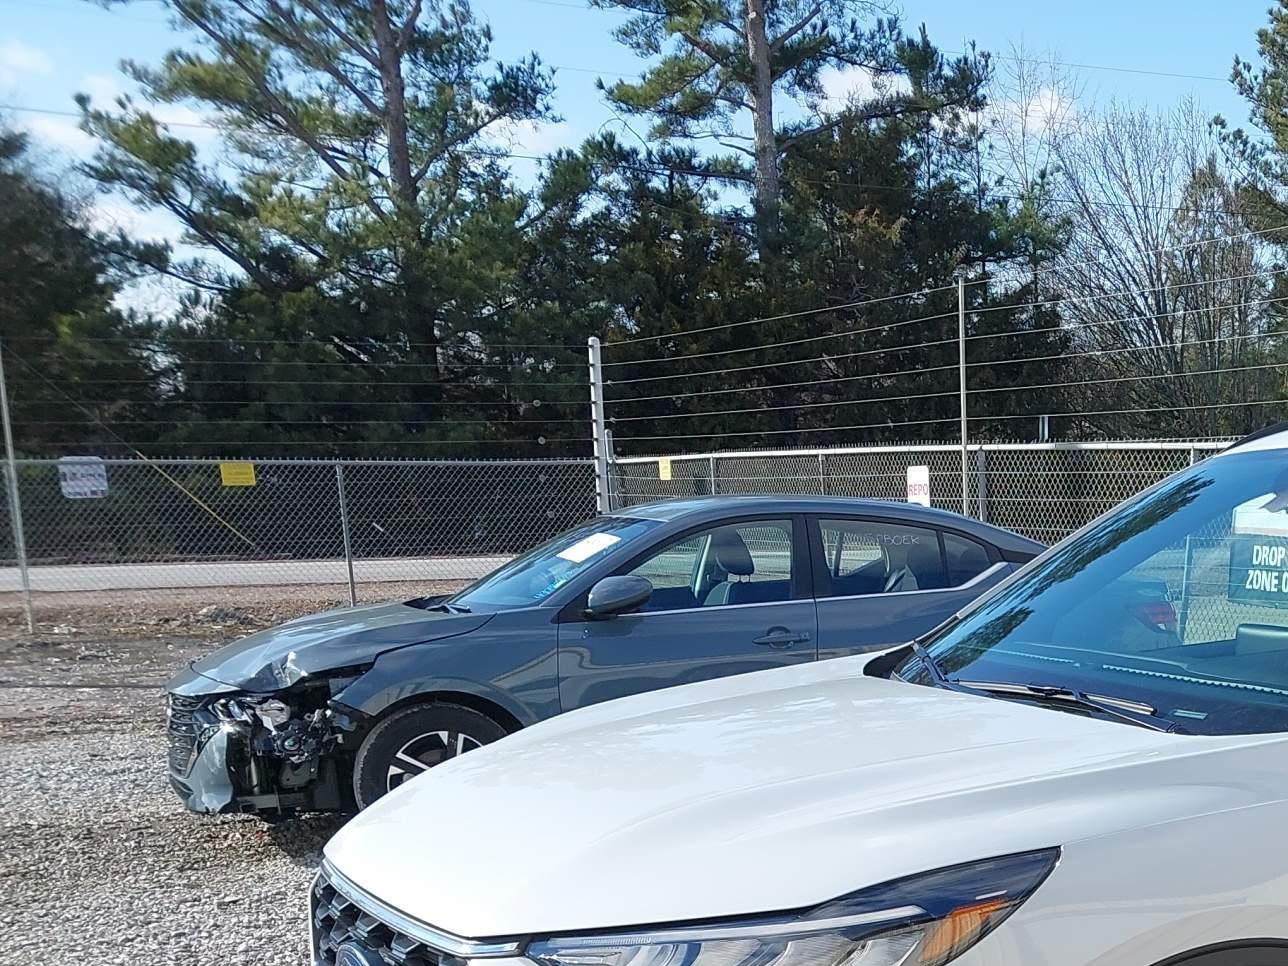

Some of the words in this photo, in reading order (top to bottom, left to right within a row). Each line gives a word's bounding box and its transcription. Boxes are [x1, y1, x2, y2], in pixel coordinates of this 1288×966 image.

[908, 483, 929, 496] REPO
[1252, 544, 1286, 567] DROP
[1245, 569, 1279, 593] ZONE
